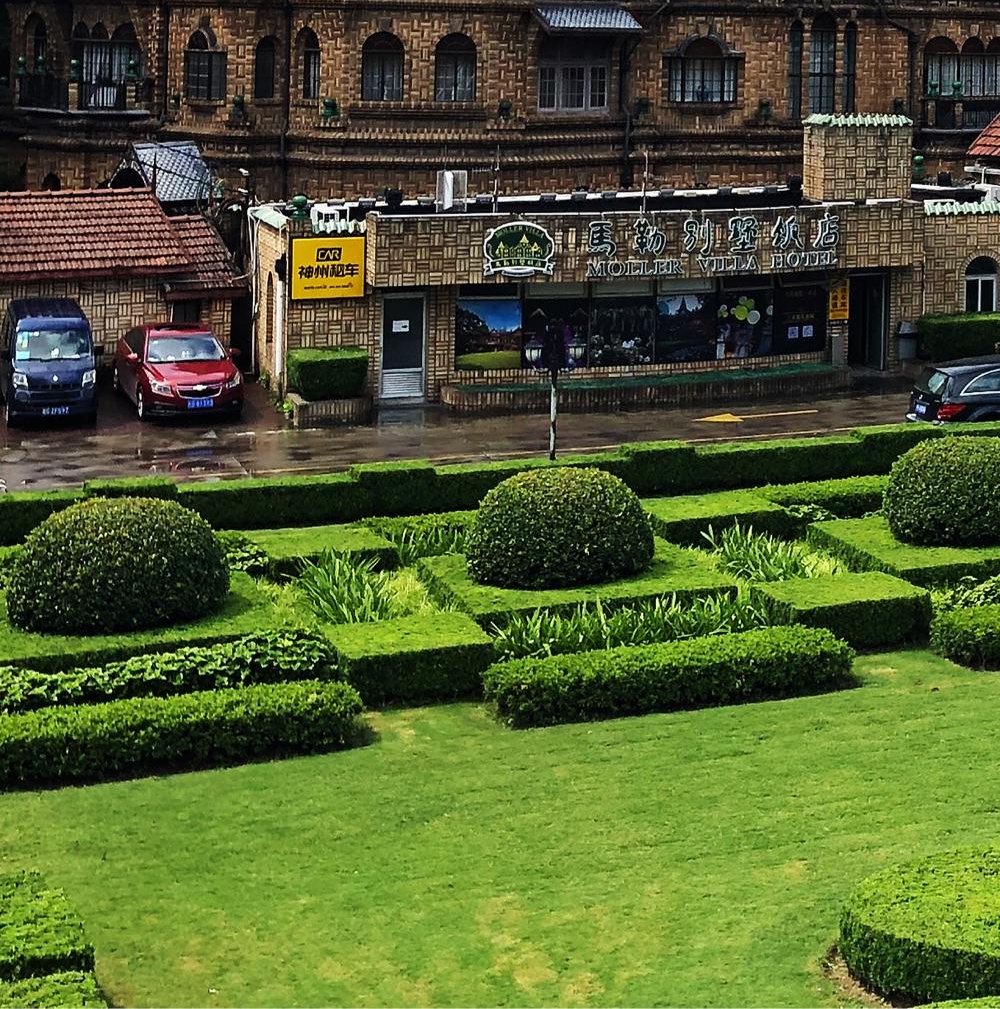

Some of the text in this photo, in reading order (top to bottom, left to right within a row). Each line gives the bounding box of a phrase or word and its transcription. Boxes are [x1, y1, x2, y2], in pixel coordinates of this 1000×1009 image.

[318, 249, 340, 260] CAR
[298, 263, 359, 279] 神州租车
[586, 250, 838, 277] MOLLER VILLA HOTEL
